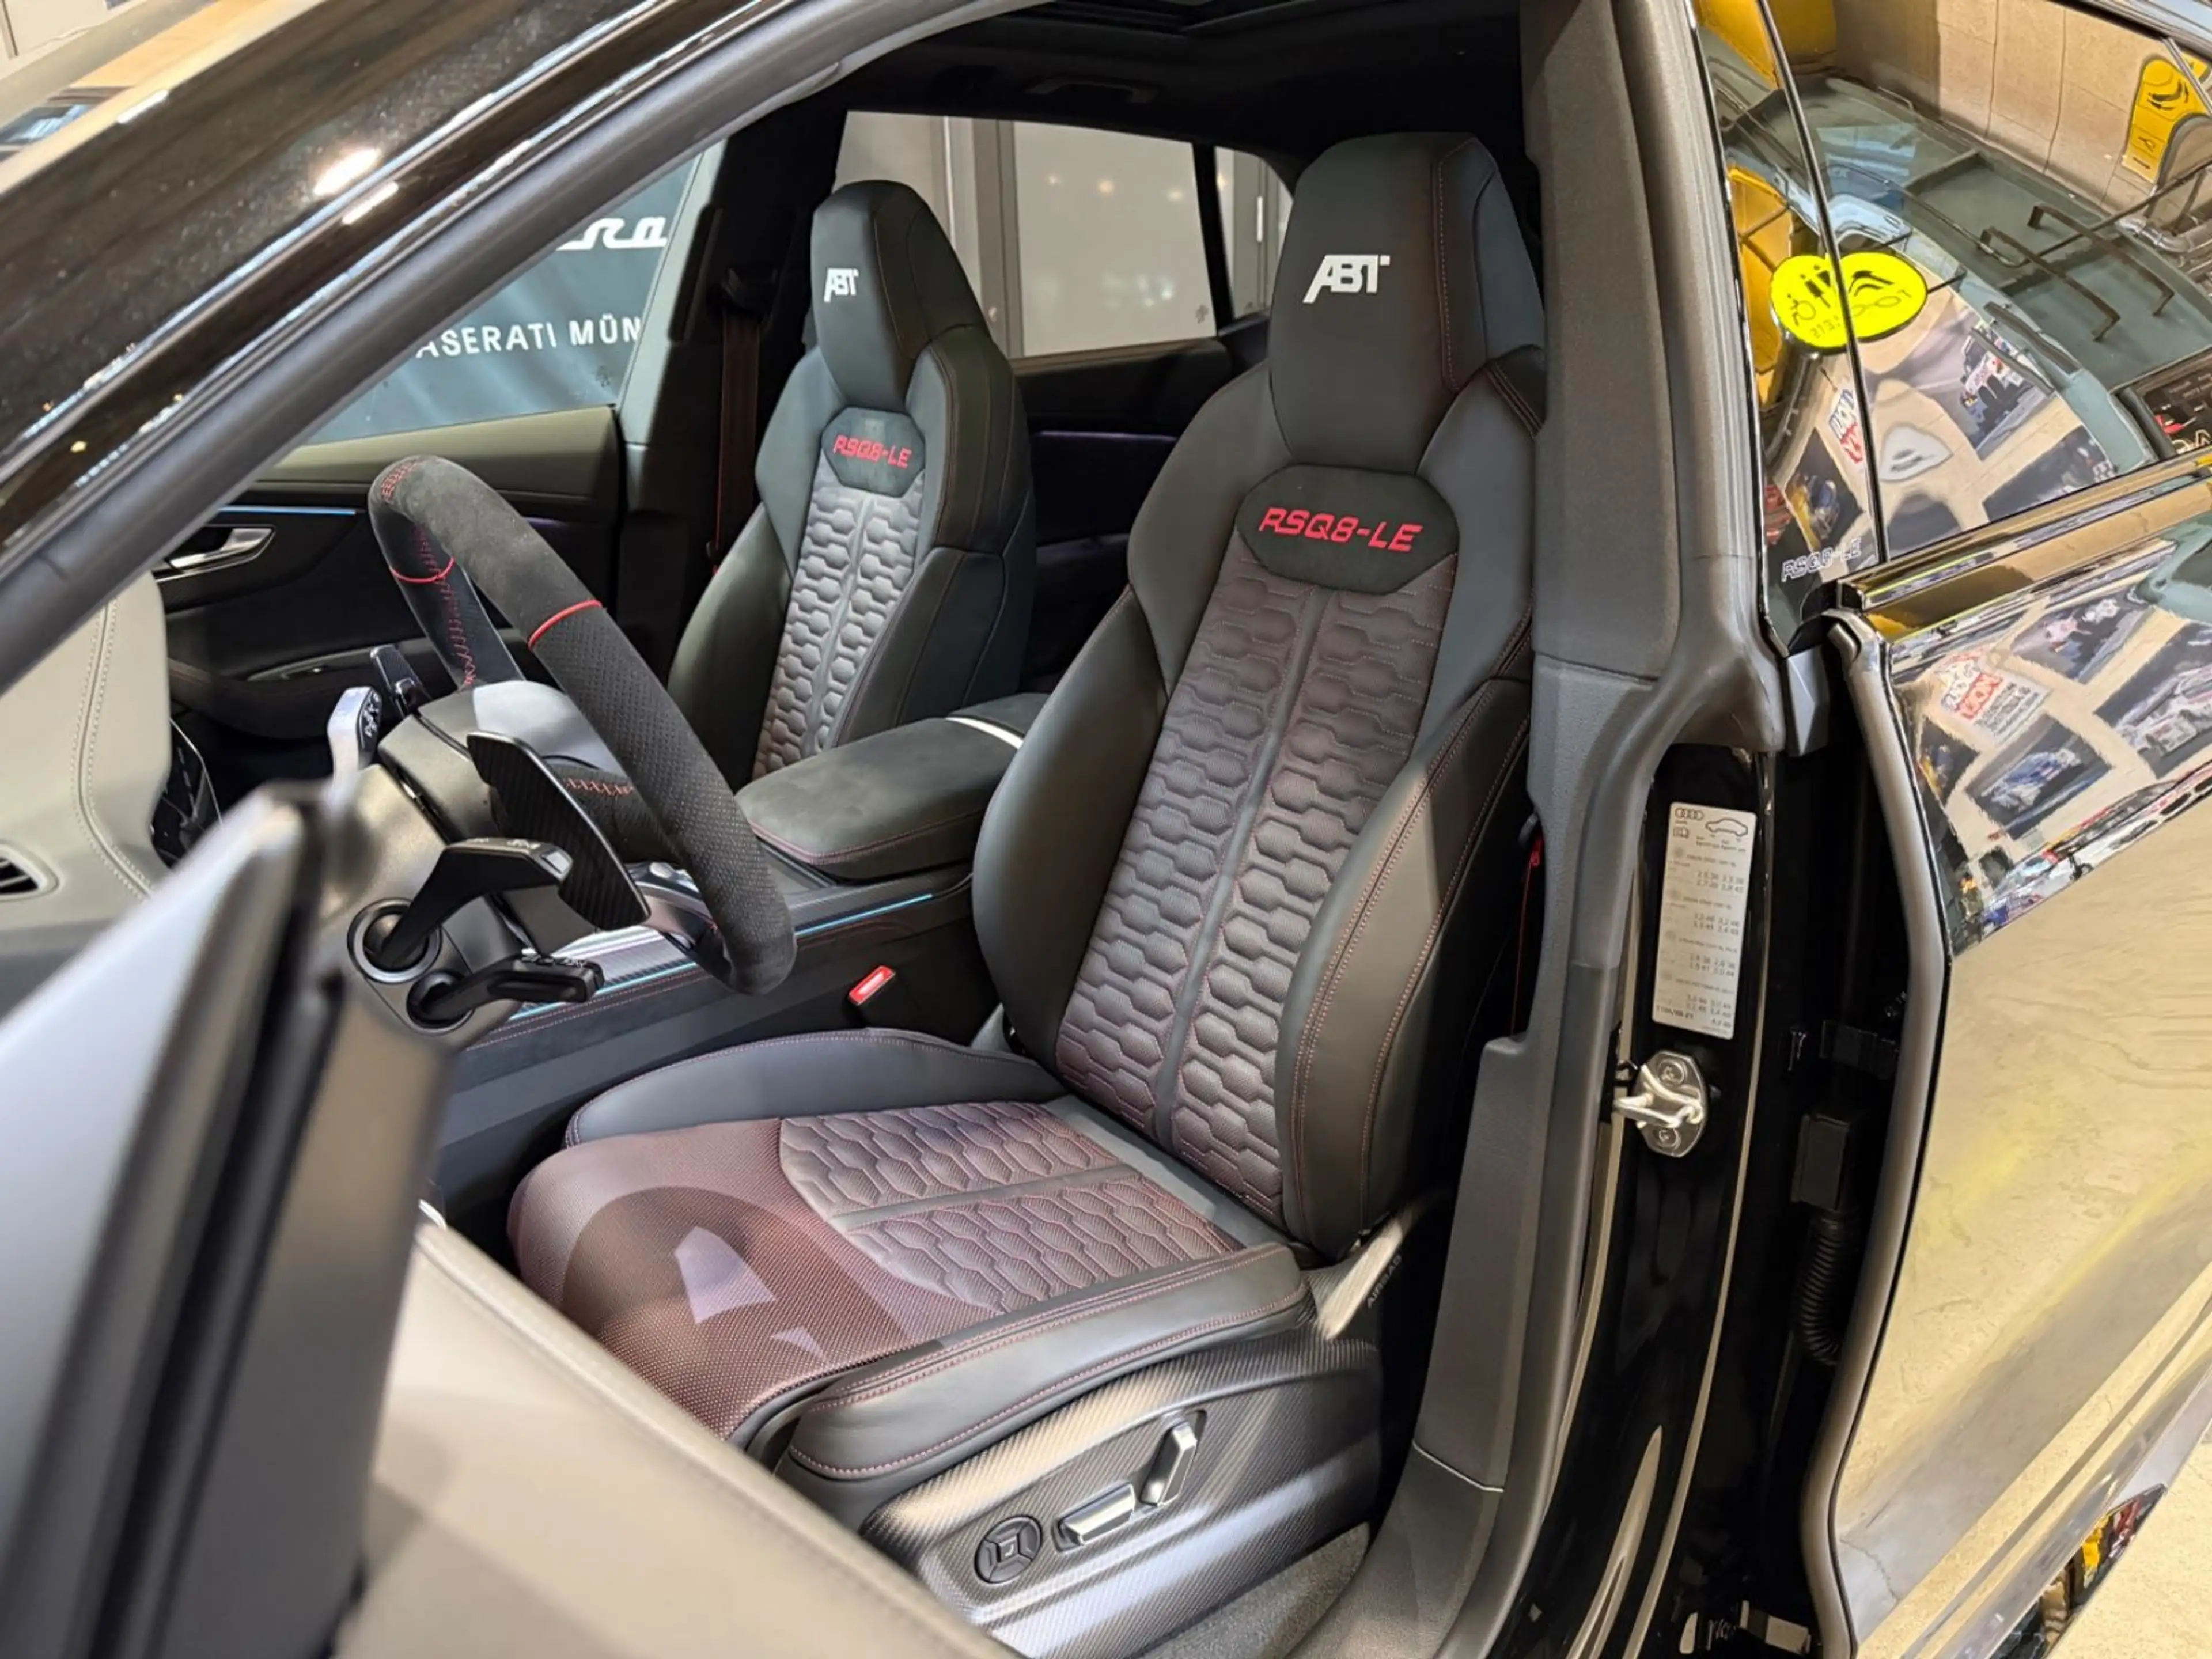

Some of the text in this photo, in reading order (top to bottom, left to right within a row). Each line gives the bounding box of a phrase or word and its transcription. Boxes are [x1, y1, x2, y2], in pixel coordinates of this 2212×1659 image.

[824, 268, 859, 303] ABT
[1302, 254, 1391, 304] ABT
[833, 434, 912, 470] RSQ8-LE
[1259, 506, 1424, 552] RSQ8-LE
